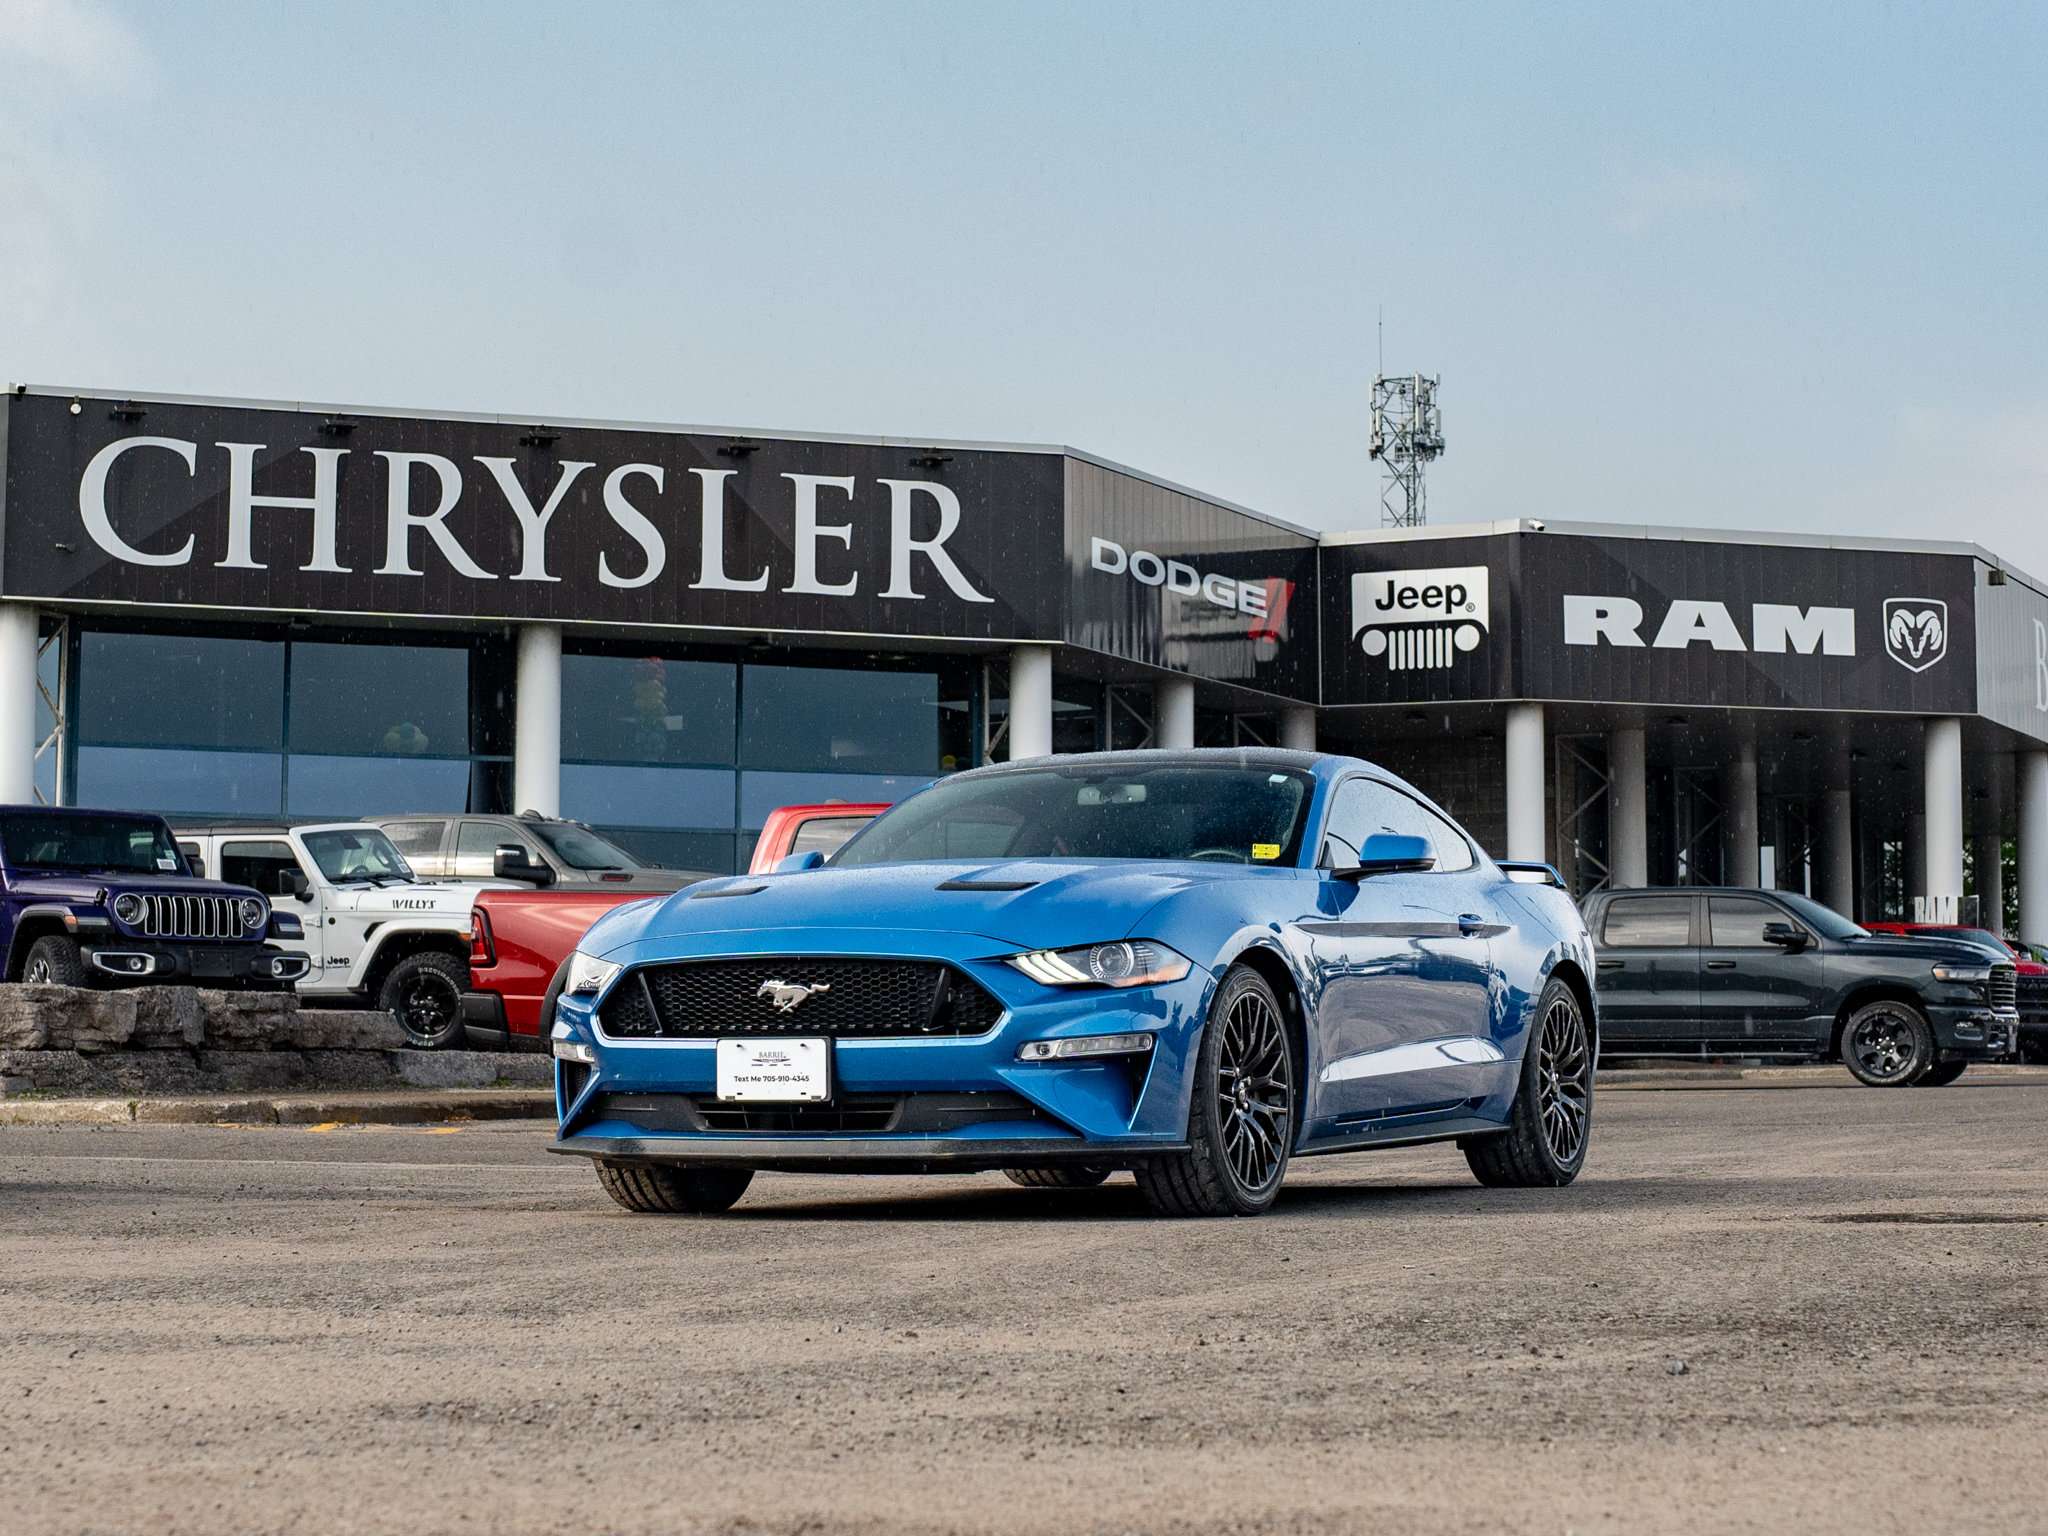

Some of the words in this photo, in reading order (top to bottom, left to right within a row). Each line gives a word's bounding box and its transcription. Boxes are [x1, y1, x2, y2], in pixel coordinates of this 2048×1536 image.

[78, 435, 995, 603] CHRYSLER
[1091, 536, 1268, 619] DODGE
[1563, 594, 1856, 656] RAM
[392, 899, 437, 910] WILLYS
[1914, 896, 1958, 926] RAM
[326, 955, 350, 967] Jeep
